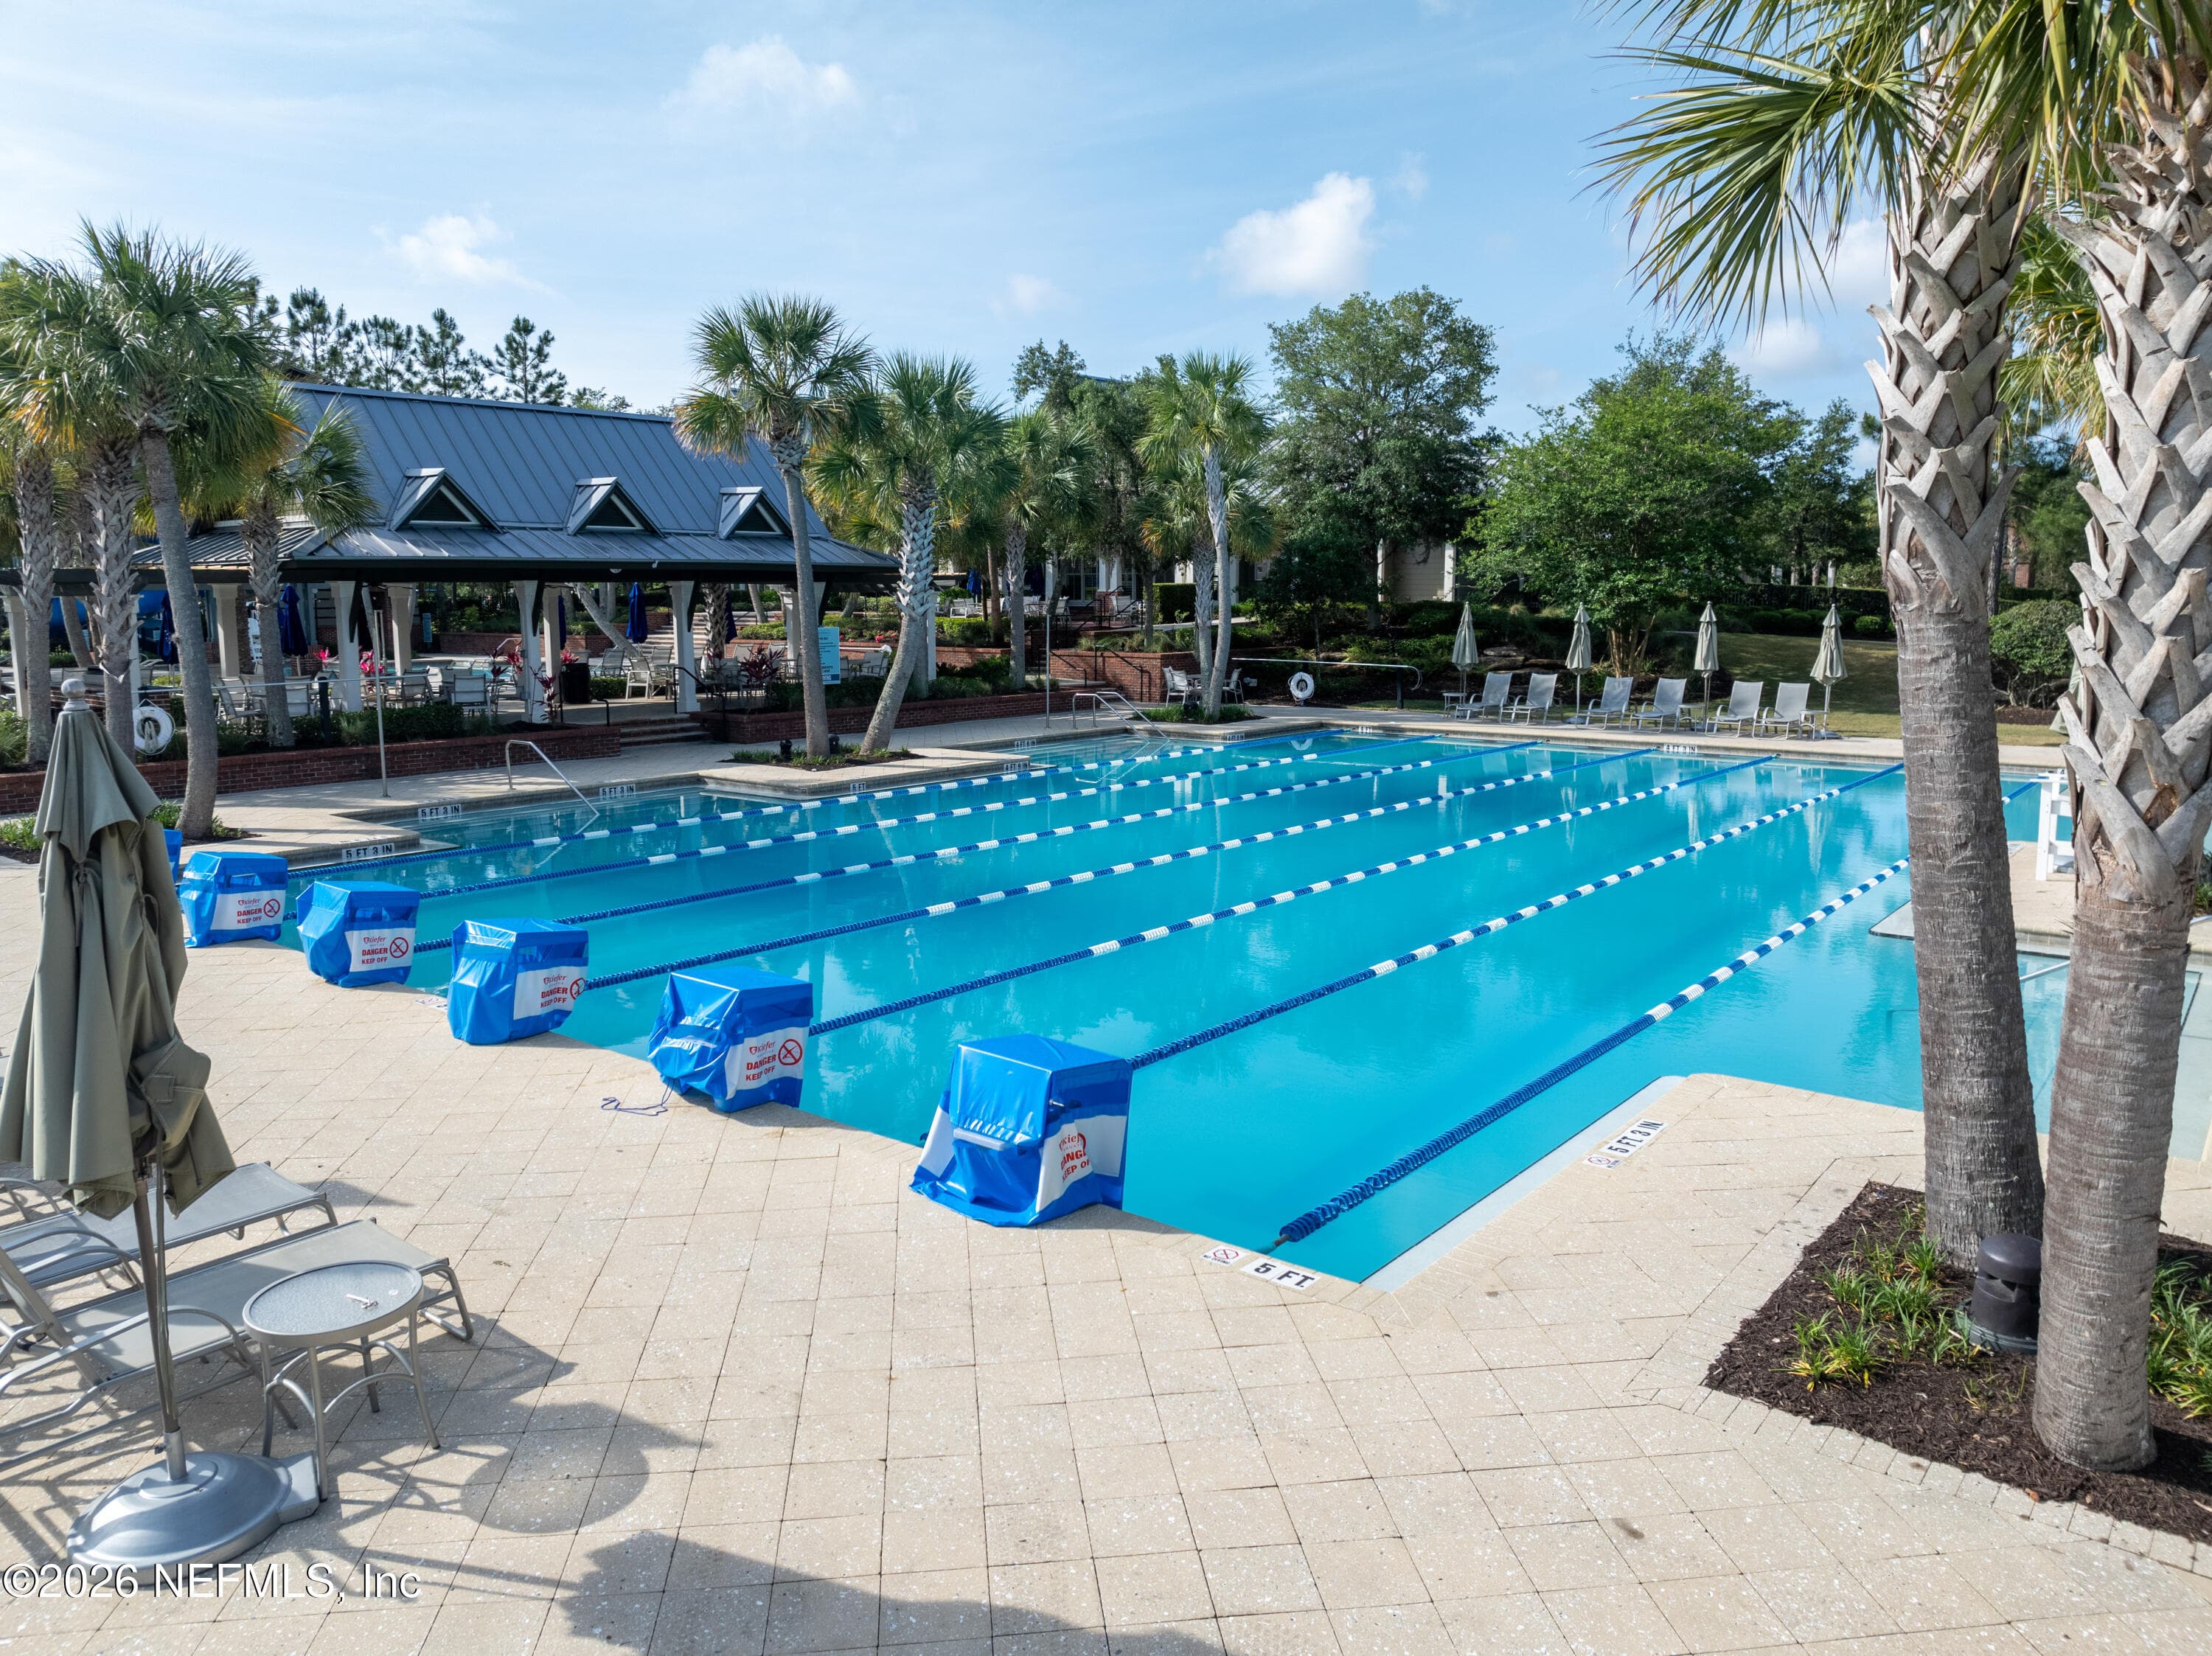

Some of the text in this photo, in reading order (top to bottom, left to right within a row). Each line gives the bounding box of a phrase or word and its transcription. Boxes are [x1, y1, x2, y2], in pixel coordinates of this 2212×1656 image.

[609, 787, 617, 796] FT
[627, 784, 634, 794] IN
[858, 782, 866, 790] FT
[429, 807, 439, 816] FT
[451, 804, 459, 814] IN
[346, 844, 392, 858] 5 FT 3 IN
[237, 908, 262, 917] DANGER
[361, 947, 389, 956] DANGER
[540, 987, 568, 999] DANGER
[540, 998, 553, 1008] KEEP
[746, 1054, 776, 1071] DANGER
[745, 1065, 776, 1081] KEEP OFF
[1637, 1121, 1664, 1130] IN
[1616, 1135, 1644, 1147] FT
[1607, 1145, 1630, 1153] 5
[1253, 1262, 1277, 1274] 5
